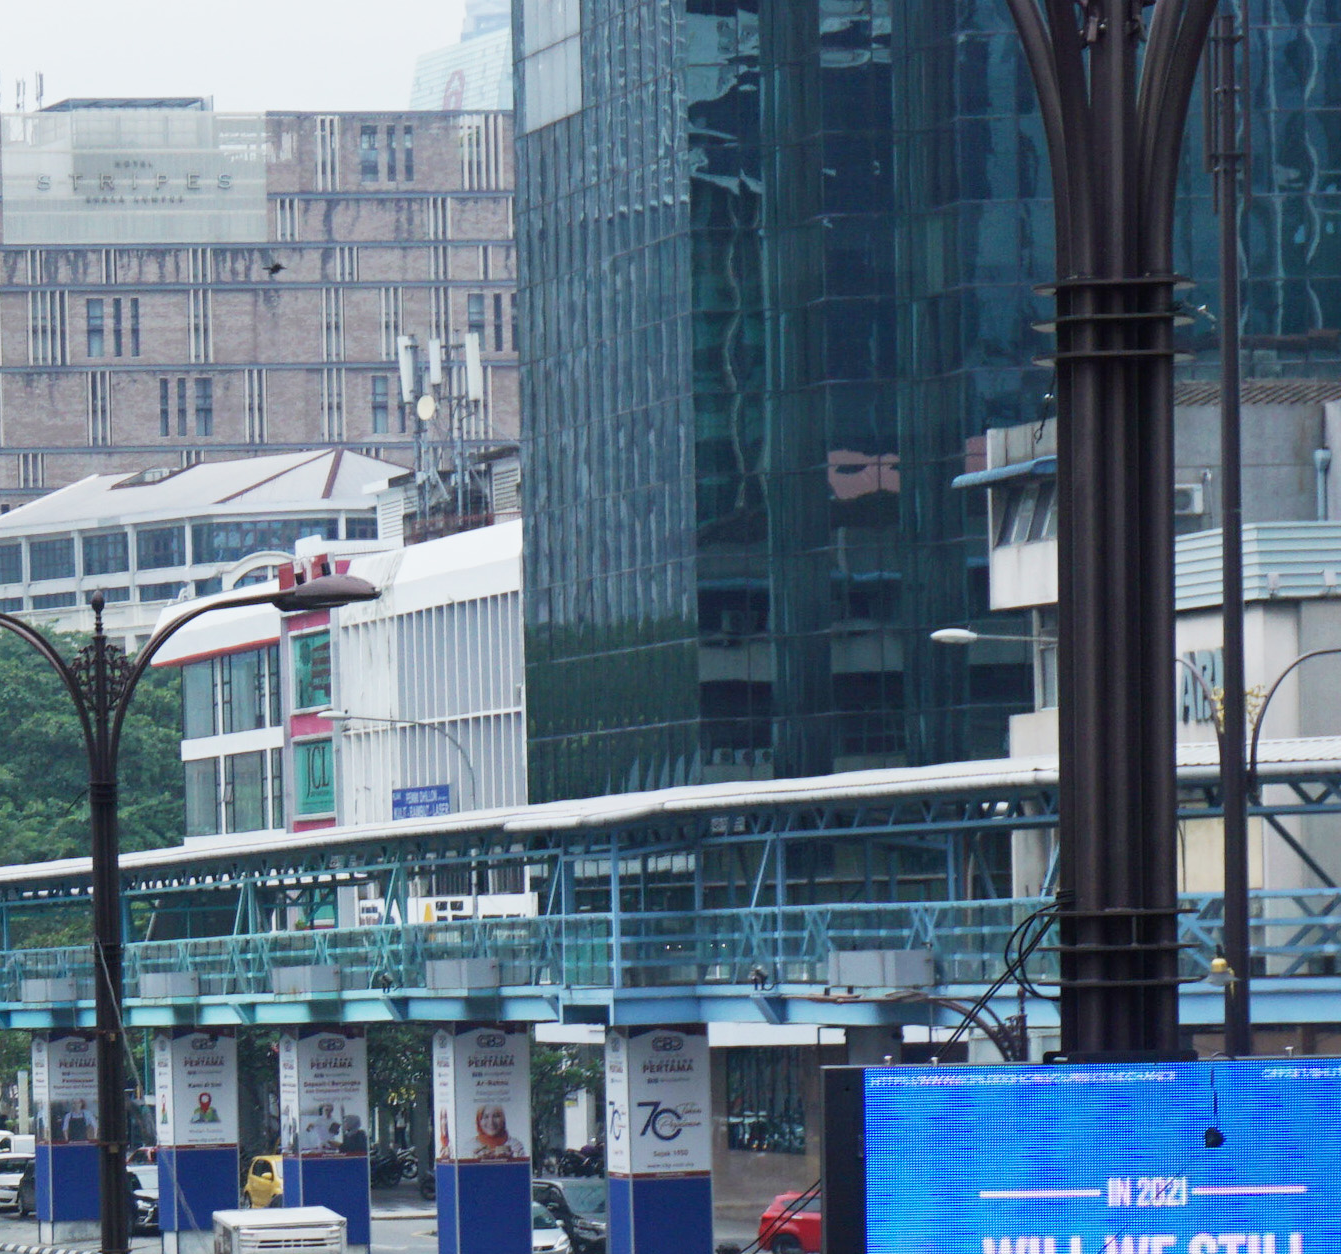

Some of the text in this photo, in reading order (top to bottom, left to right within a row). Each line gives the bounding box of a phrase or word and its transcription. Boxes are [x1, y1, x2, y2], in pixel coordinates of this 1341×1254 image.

[37, 173, 232, 191] STRIPES
[184, 1058, 225, 1067] PERTAMA
[310, 1061, 353, 1069] PERTAMA
[468, 1059, 515, 1068] PERTAMA
[643, 1063, 694, 1073] PERTAMA
[1107, 1177, 1130, 1207] IN
